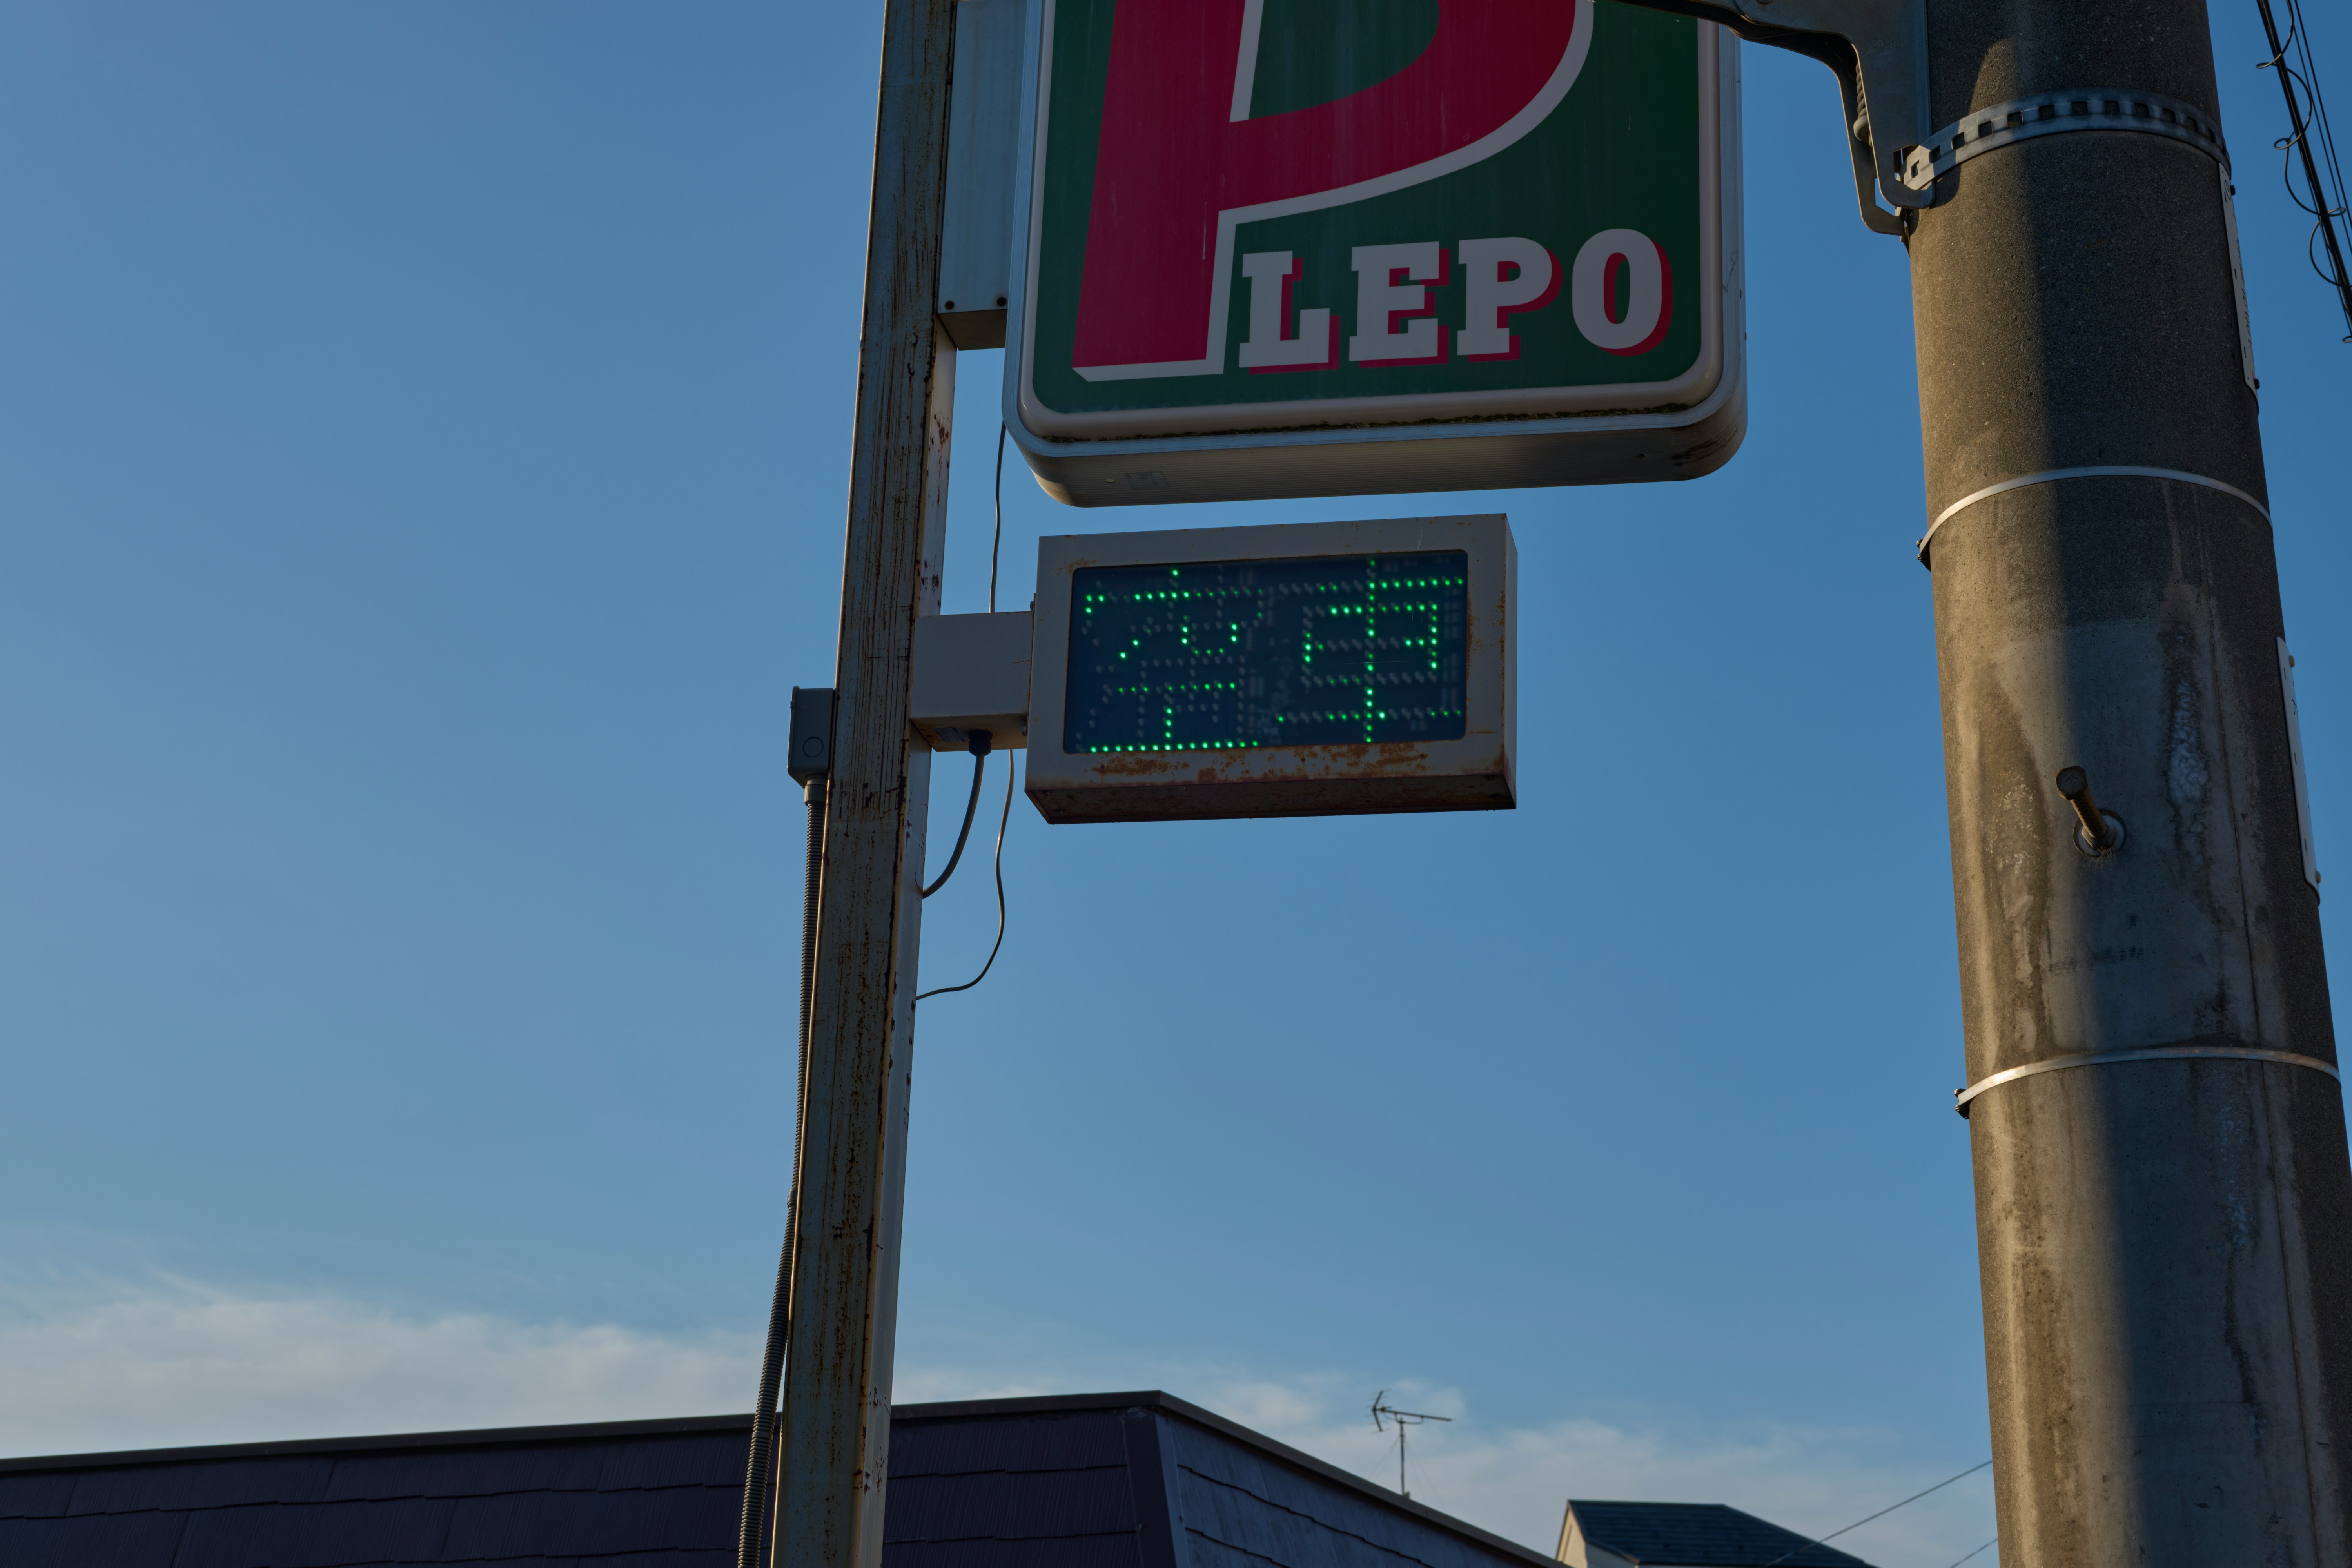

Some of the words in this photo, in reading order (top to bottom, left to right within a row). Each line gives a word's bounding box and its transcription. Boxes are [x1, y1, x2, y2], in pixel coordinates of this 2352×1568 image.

[1071, 0, 1594, 381] P
[1239, 229, 1673, 375] LEPO
[1085, 561, 1463, 753] 空車
